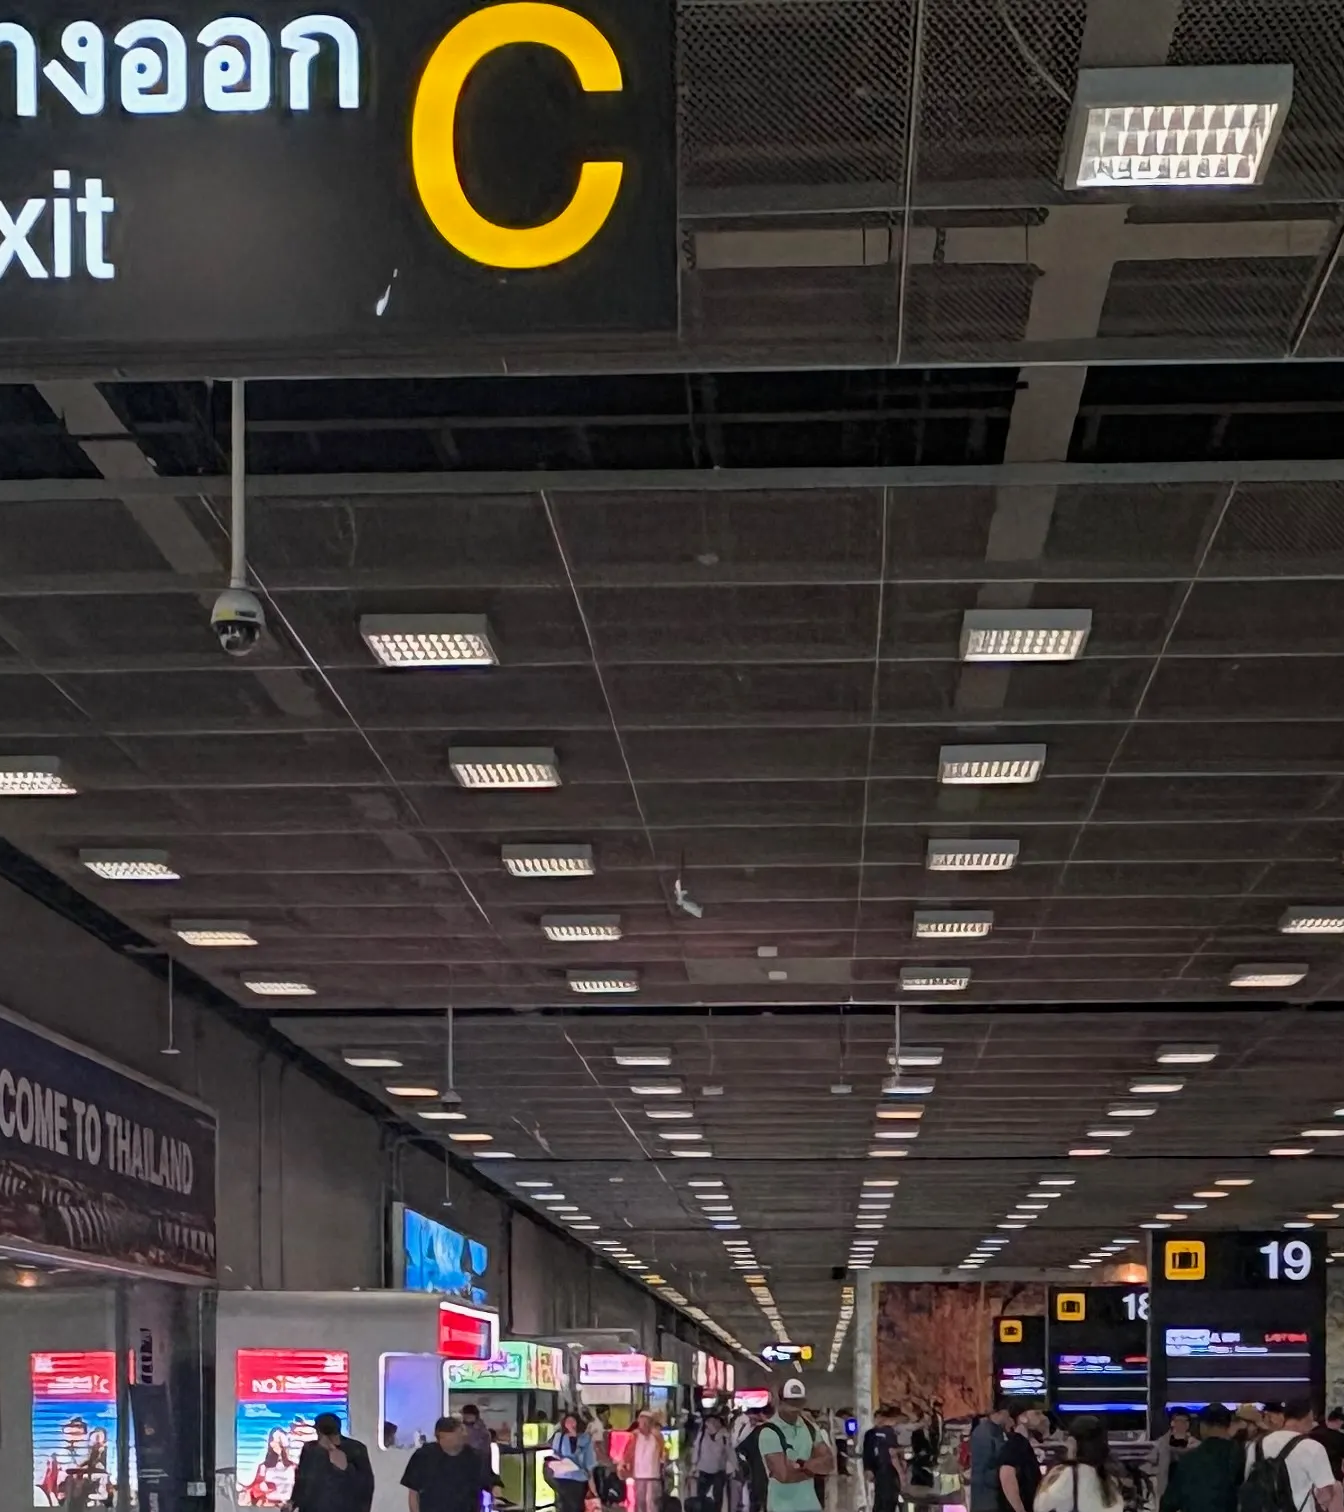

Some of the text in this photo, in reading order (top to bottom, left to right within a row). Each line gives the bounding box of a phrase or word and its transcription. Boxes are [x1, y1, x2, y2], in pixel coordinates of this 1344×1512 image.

[411, 0, 624, 270] C
[72, 1097, 102, 1166] TO
[105, 1111, 194, 1195] THAILAND
[1259, 1240, 1312, 1281] 19
